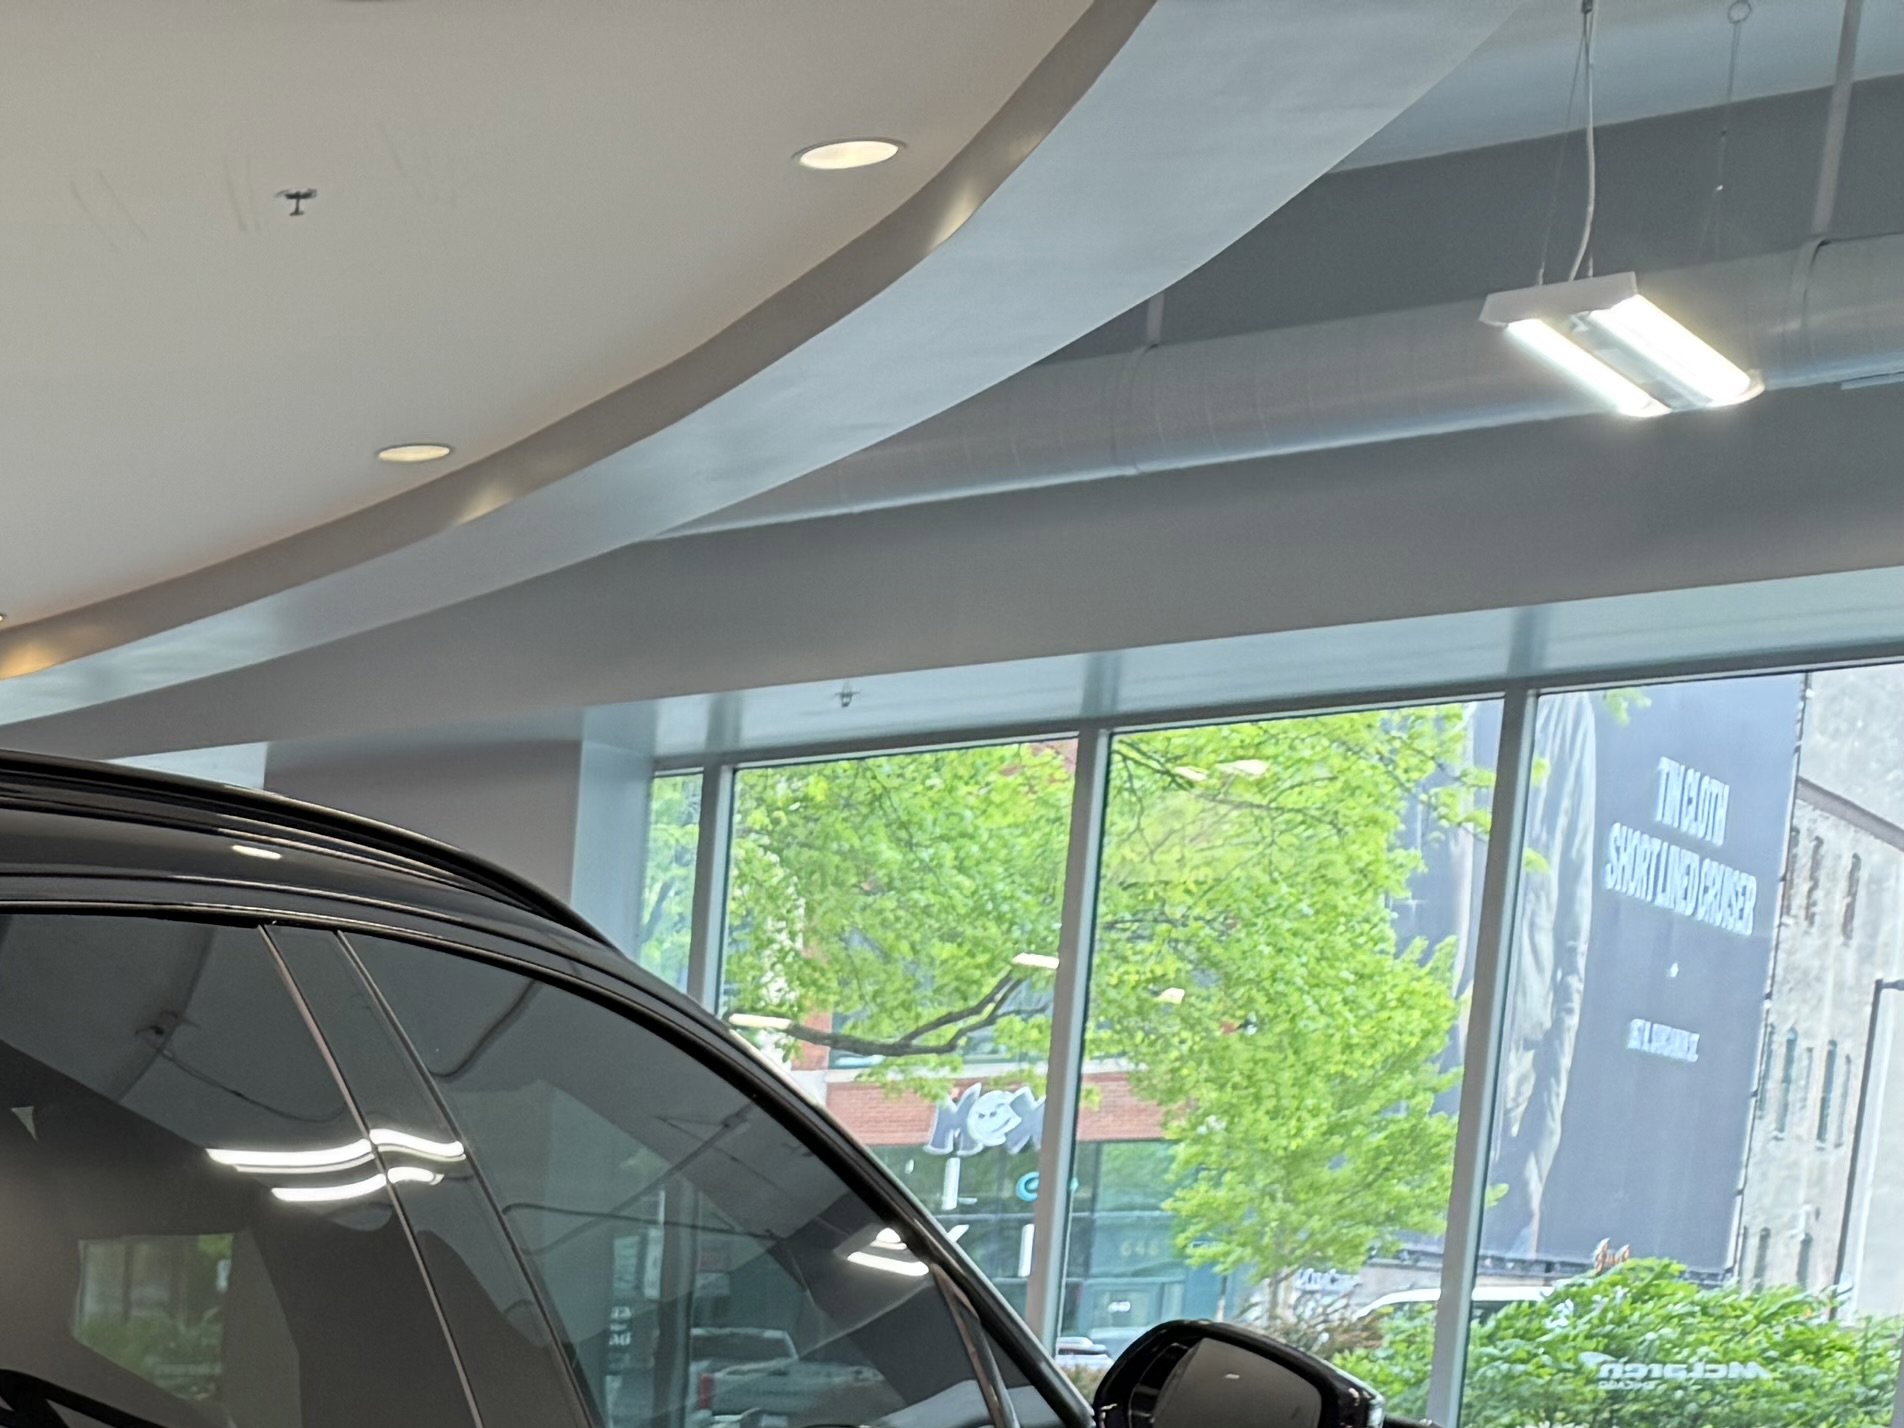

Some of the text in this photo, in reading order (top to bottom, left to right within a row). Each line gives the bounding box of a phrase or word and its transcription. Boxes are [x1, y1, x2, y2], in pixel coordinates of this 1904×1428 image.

[1680, 768, 1729, 847] CLOTH
[1605, 822, 1757, 936] SHORT LINED CRUISER
